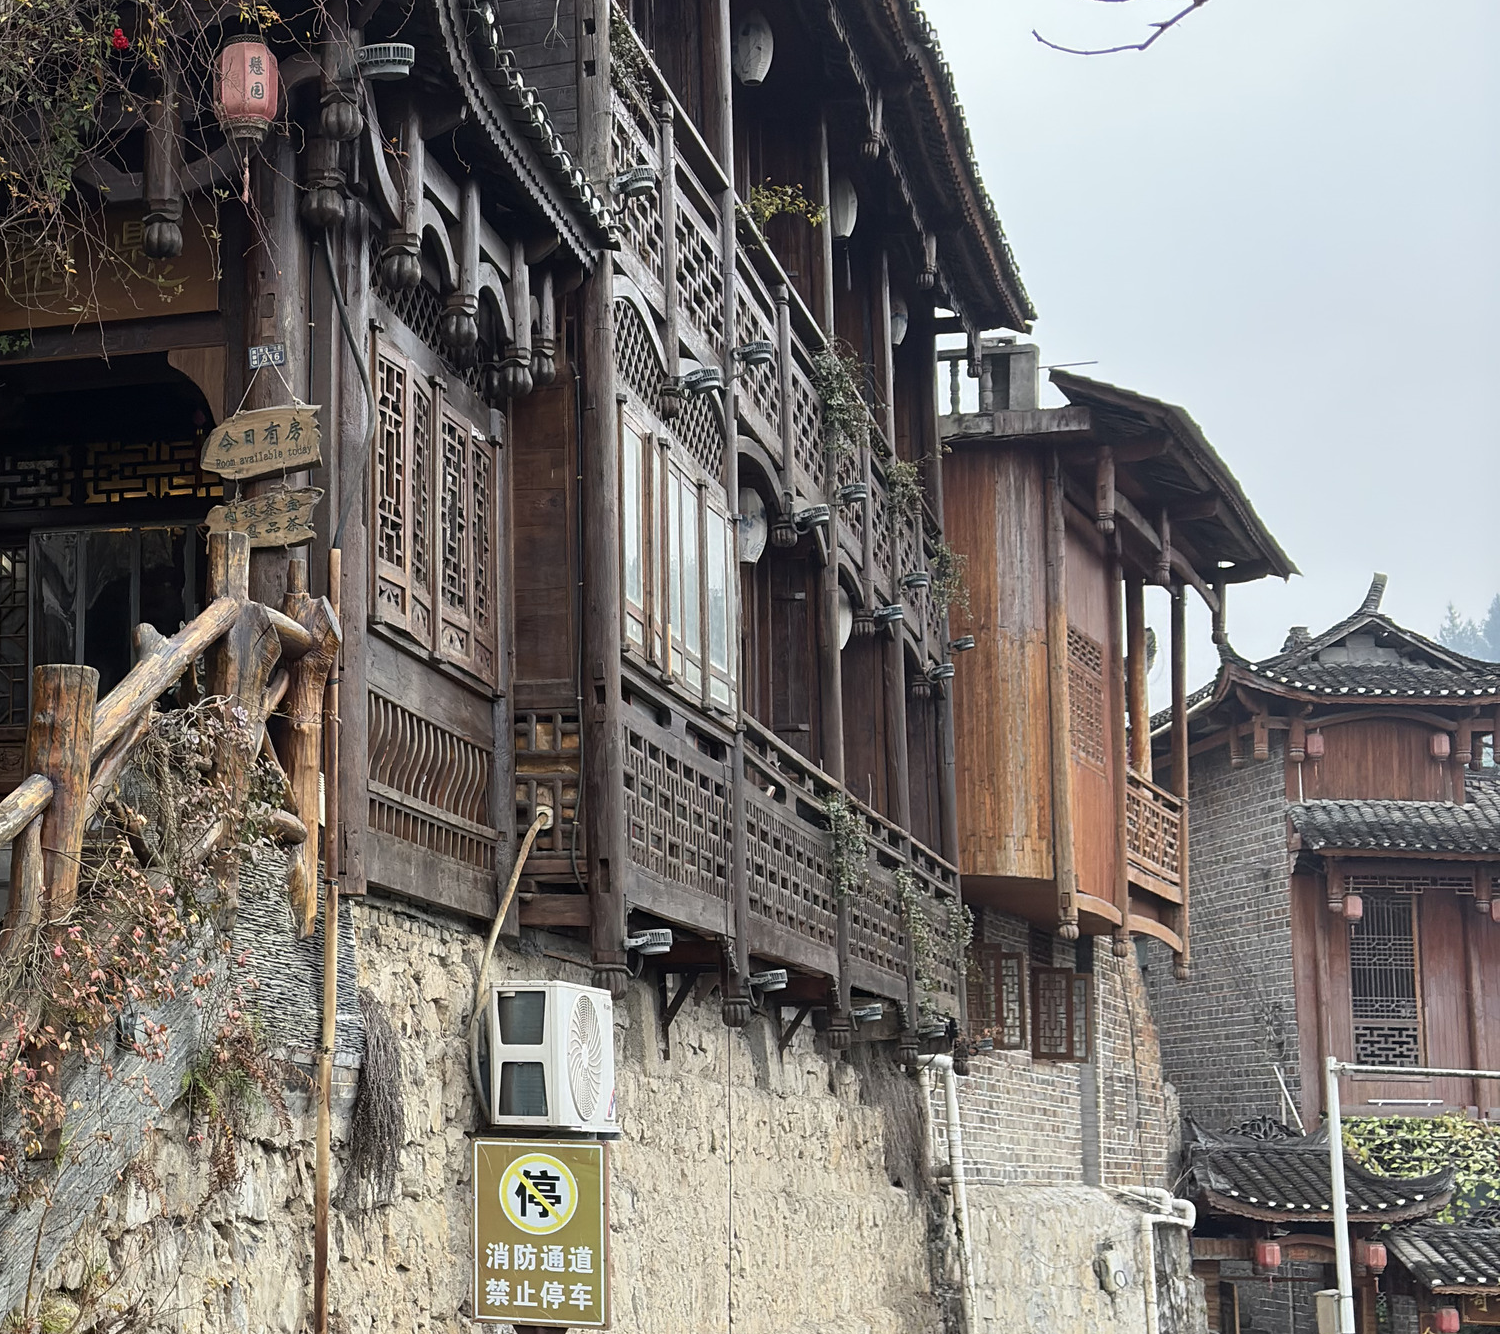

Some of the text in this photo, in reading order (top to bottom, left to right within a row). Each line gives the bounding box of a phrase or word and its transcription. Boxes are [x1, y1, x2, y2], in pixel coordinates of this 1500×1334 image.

[218, 417, 303, 452] 今日有房
[215, 444, 312, 469] Room available today
[226, 515, 303, 539] 息品茶
[514, 1169, 562, 1218] 停
[485, 1242, 593, 1274] 消防通道
[485, 1278, 593, 1311] 禁止停车
